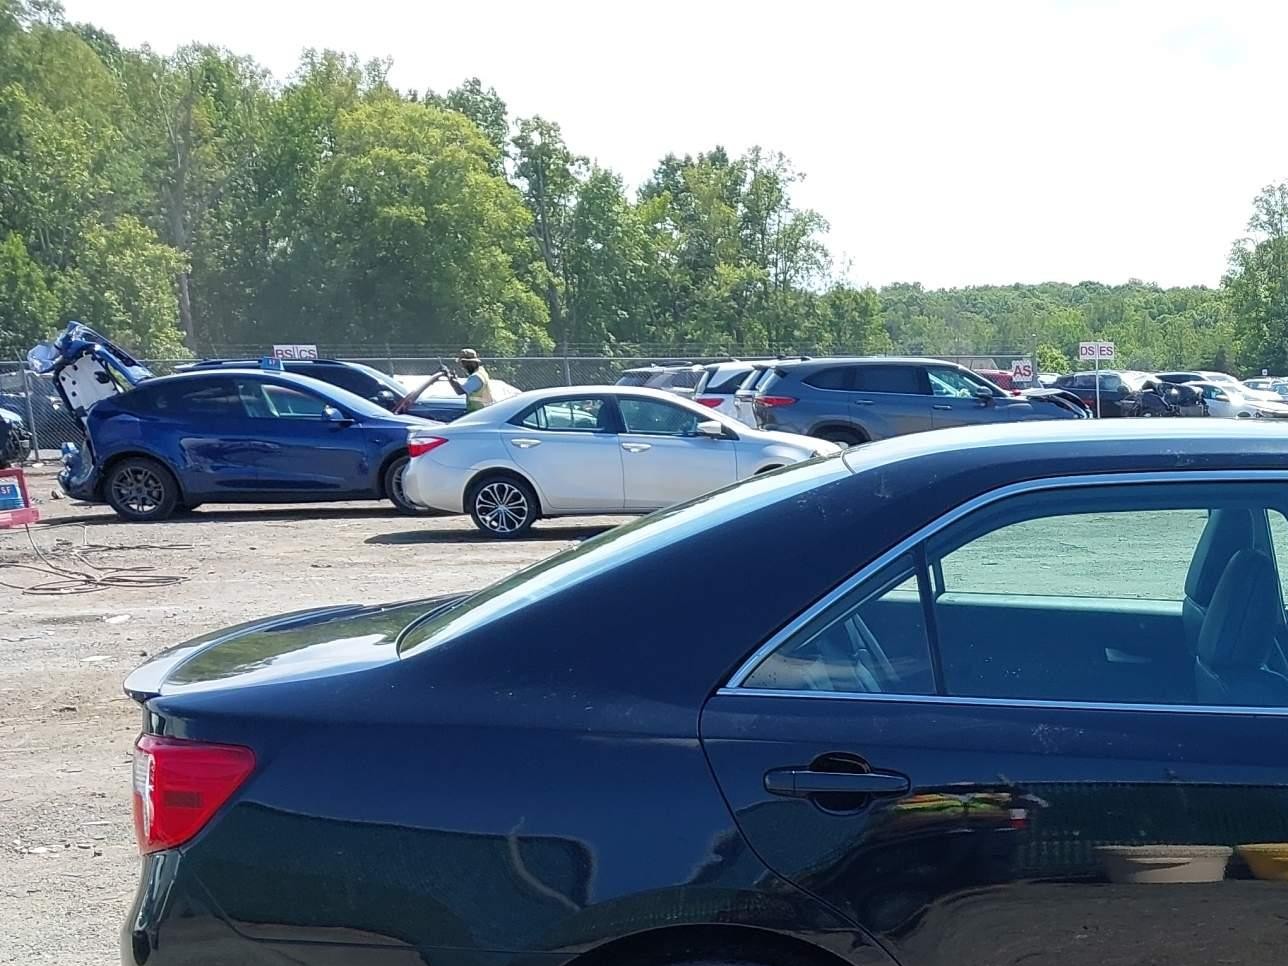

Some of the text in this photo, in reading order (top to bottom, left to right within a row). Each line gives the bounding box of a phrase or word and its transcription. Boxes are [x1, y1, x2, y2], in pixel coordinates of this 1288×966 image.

[275, 349, 317, 360] BS CS
[1080, 346, 1114, 356] DS ES
[1013, 365, 1032, 377] AS
